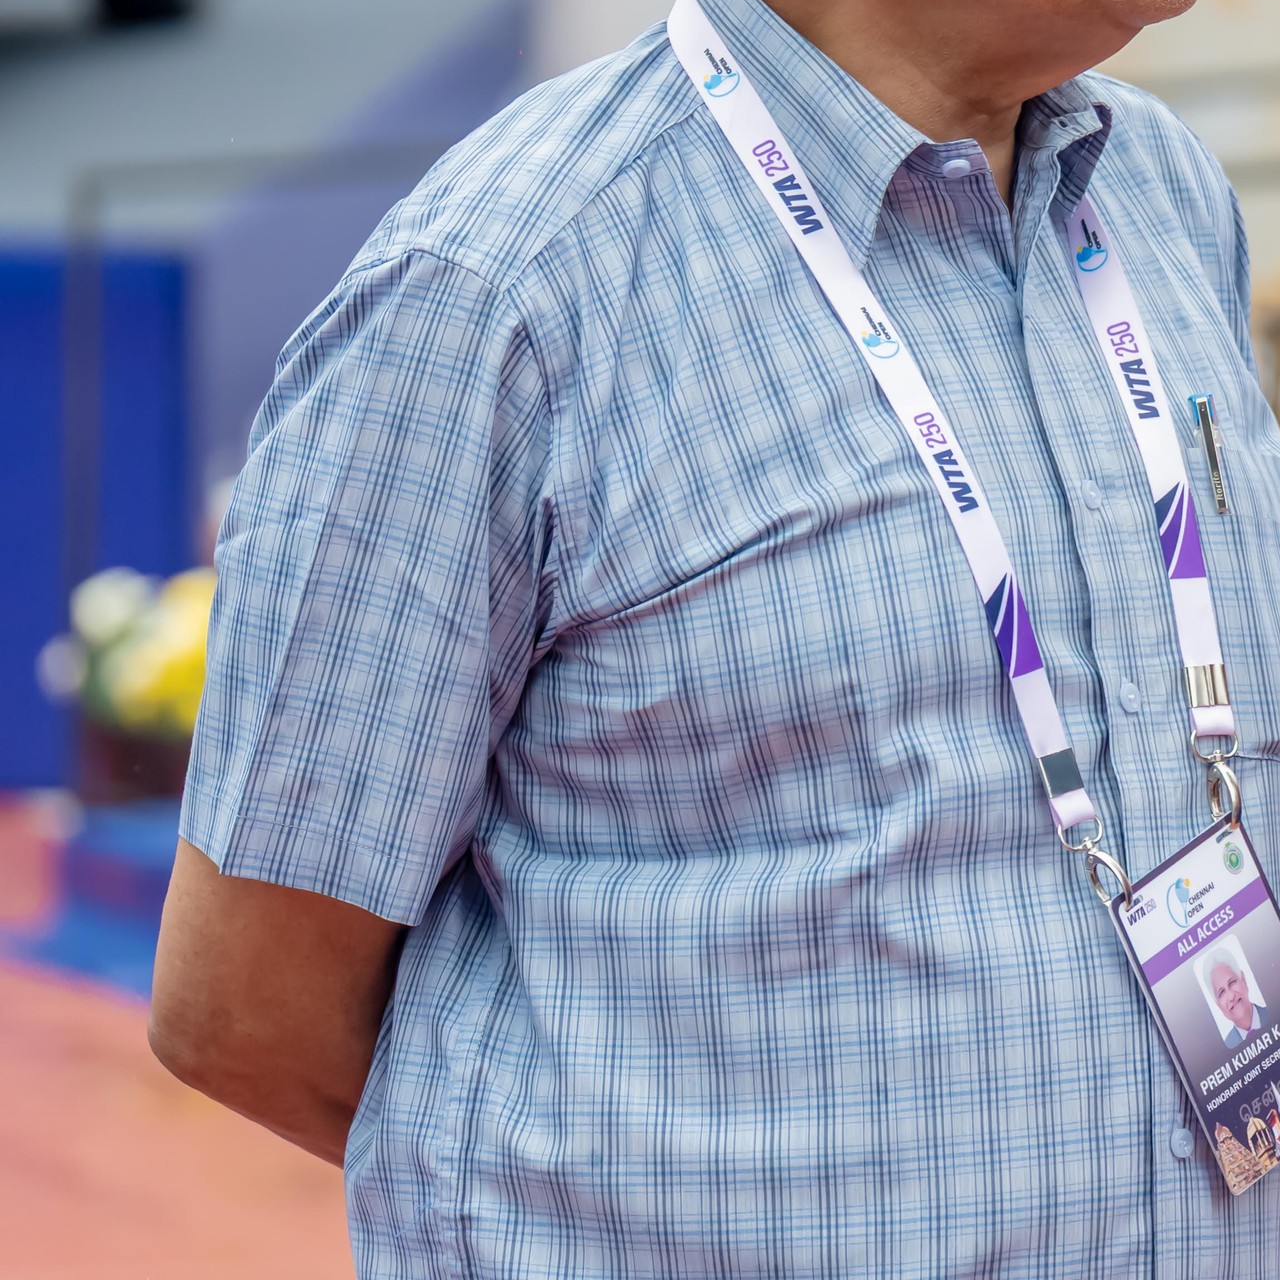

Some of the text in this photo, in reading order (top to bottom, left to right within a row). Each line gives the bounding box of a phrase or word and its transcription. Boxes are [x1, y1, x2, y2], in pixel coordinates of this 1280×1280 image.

[752, 139, 824, 235] WTA 250
[1106, 321, 1160, 420] WTA 250
[913, 412, 979, 513] WTA 250
[1127, 898, 1157, 926] WTA 250
[1187, 902, 1204, 918] OPEN
[1188, 882, 1215, 905] CHENNAI
[1177, 905, 1235, 957] ALL ACCESS
[1200, 1062, 1233, 1096] PREM
[1231, 1032, 1273, 1071] KUMAR
[1206, 1080, 1243, 1113] HONORARY
[1243, 1064, 1263, 1085] JOINT
